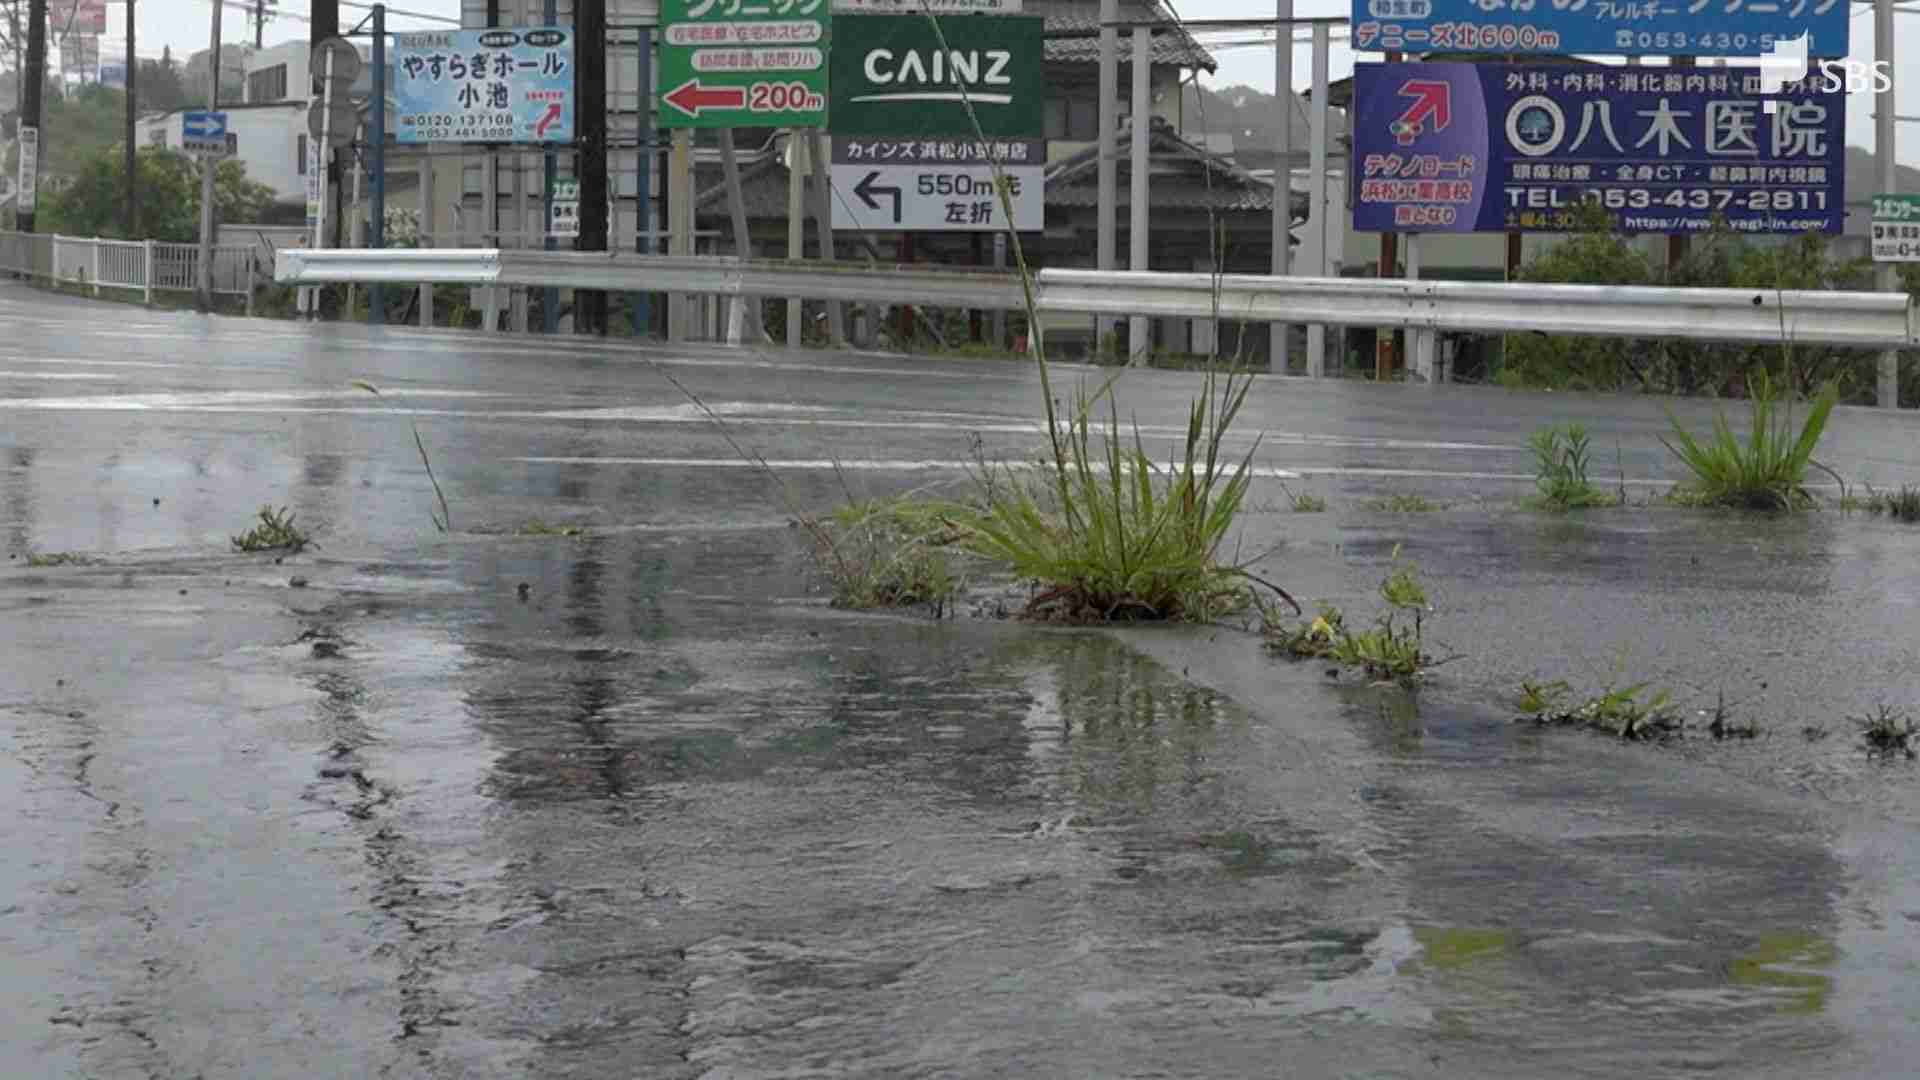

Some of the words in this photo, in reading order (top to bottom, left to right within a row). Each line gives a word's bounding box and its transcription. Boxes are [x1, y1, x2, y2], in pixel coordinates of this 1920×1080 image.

[403, 52, 565, 80] やすらぎホール
[864, 49, 1011, 83] CAINZ
[457, 82, 509, 109] 小池
[751, 83, 823, 110] 200m
[1568, 98, 1827, 157] 八木医院
[1364, 154, 1473, 178] テクノロード
[945, 201, 992, 225] 左折
